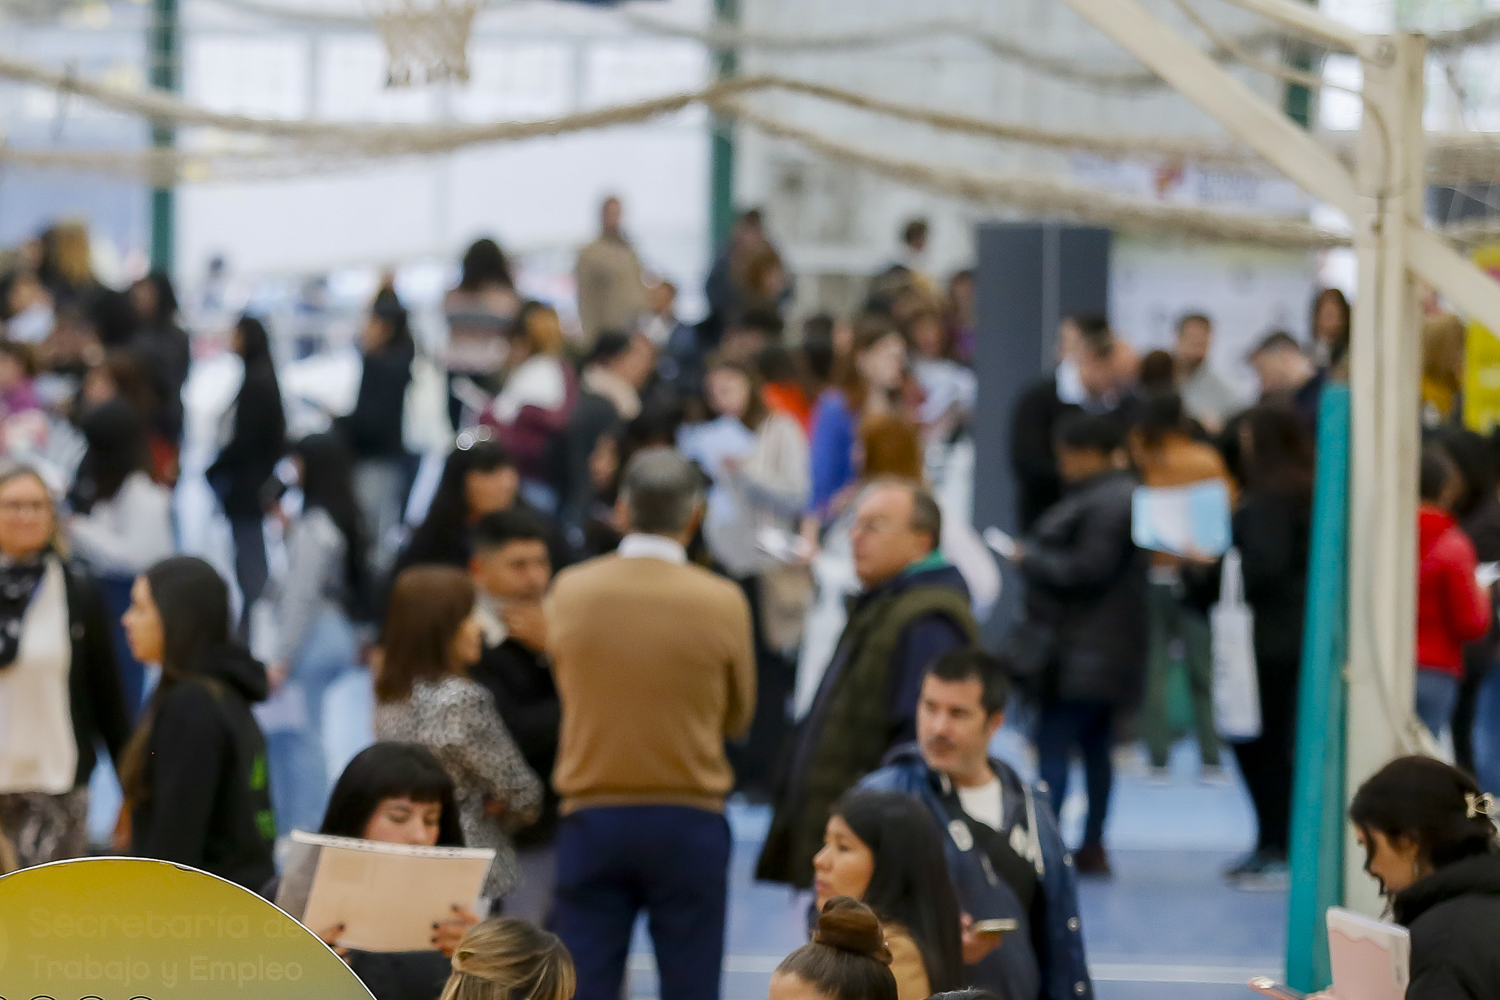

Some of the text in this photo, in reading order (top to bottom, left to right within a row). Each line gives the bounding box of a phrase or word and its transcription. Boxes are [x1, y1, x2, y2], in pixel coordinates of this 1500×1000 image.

[27, 955, 303, 988] Trabajo y Empleo
